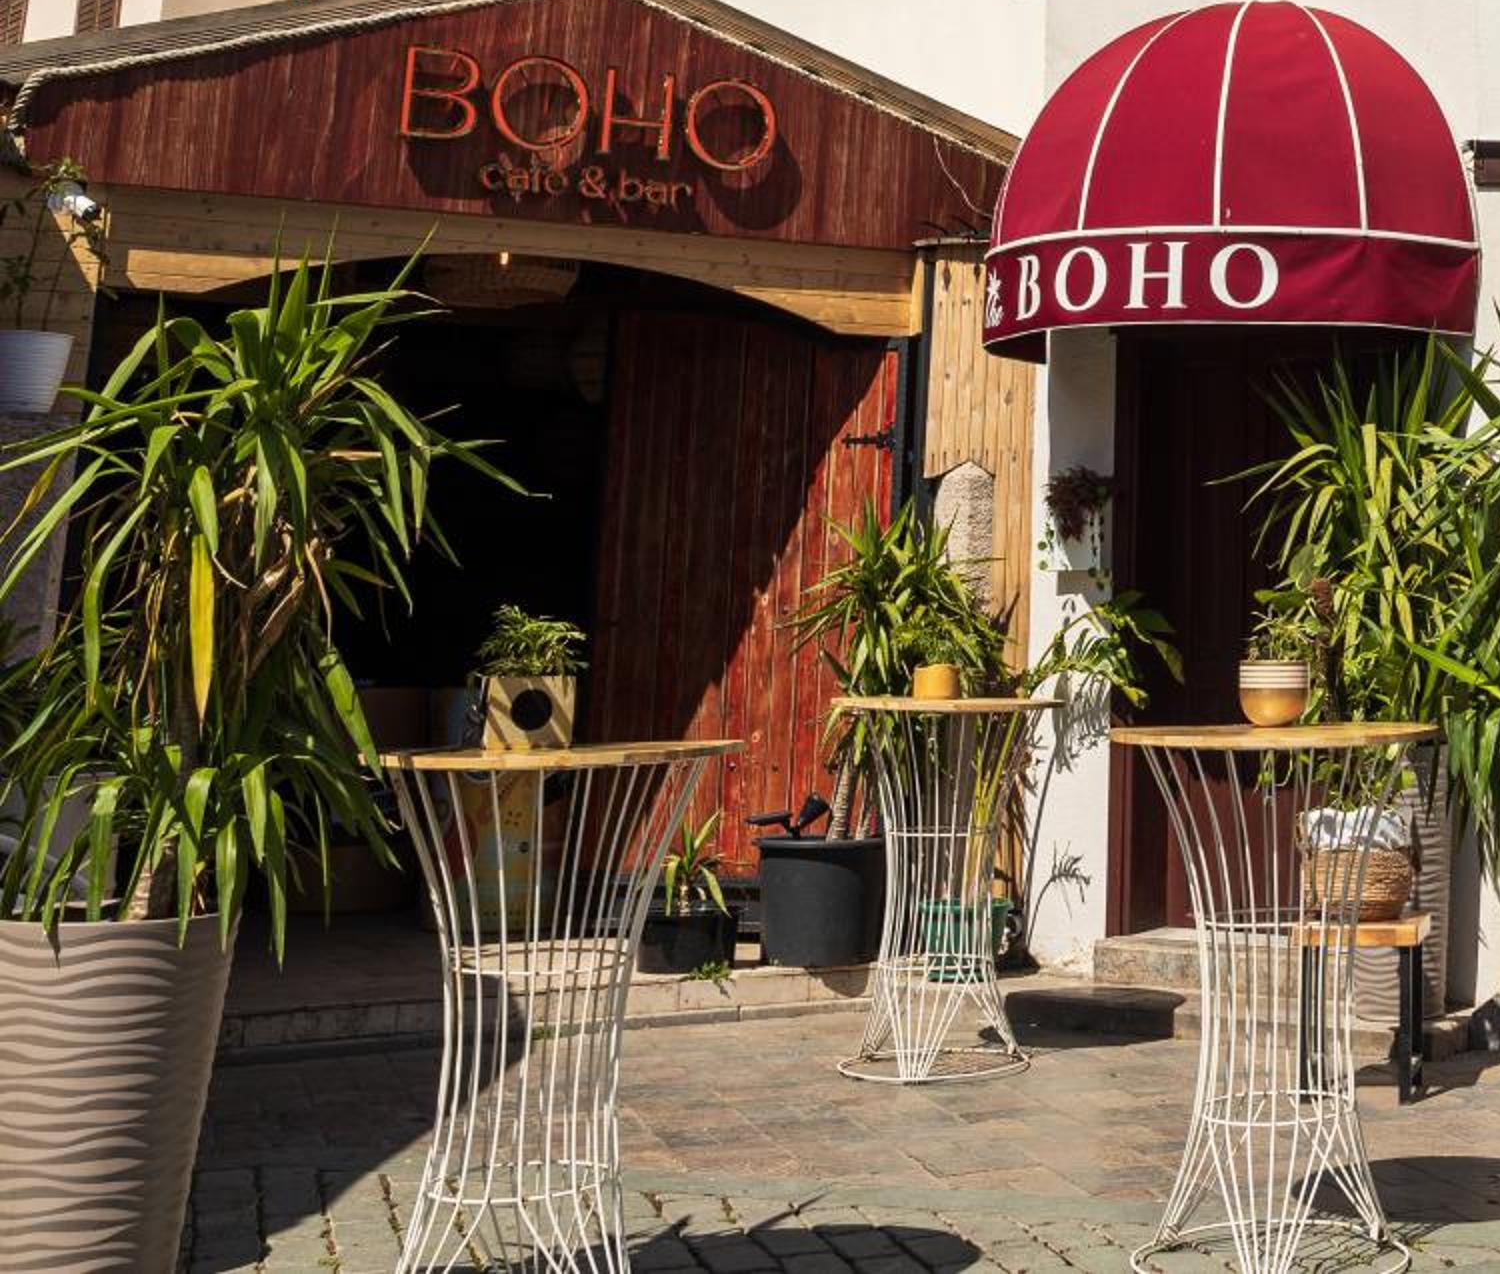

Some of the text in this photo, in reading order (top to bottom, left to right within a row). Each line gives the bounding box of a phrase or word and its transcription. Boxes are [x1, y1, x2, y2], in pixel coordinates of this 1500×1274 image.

[401, 45, 777, 171] BOHO
[579, 164, 607, 199] &
[620, 169, 693, 207] bar
[1015, 240, 1280, 321] BOHO
